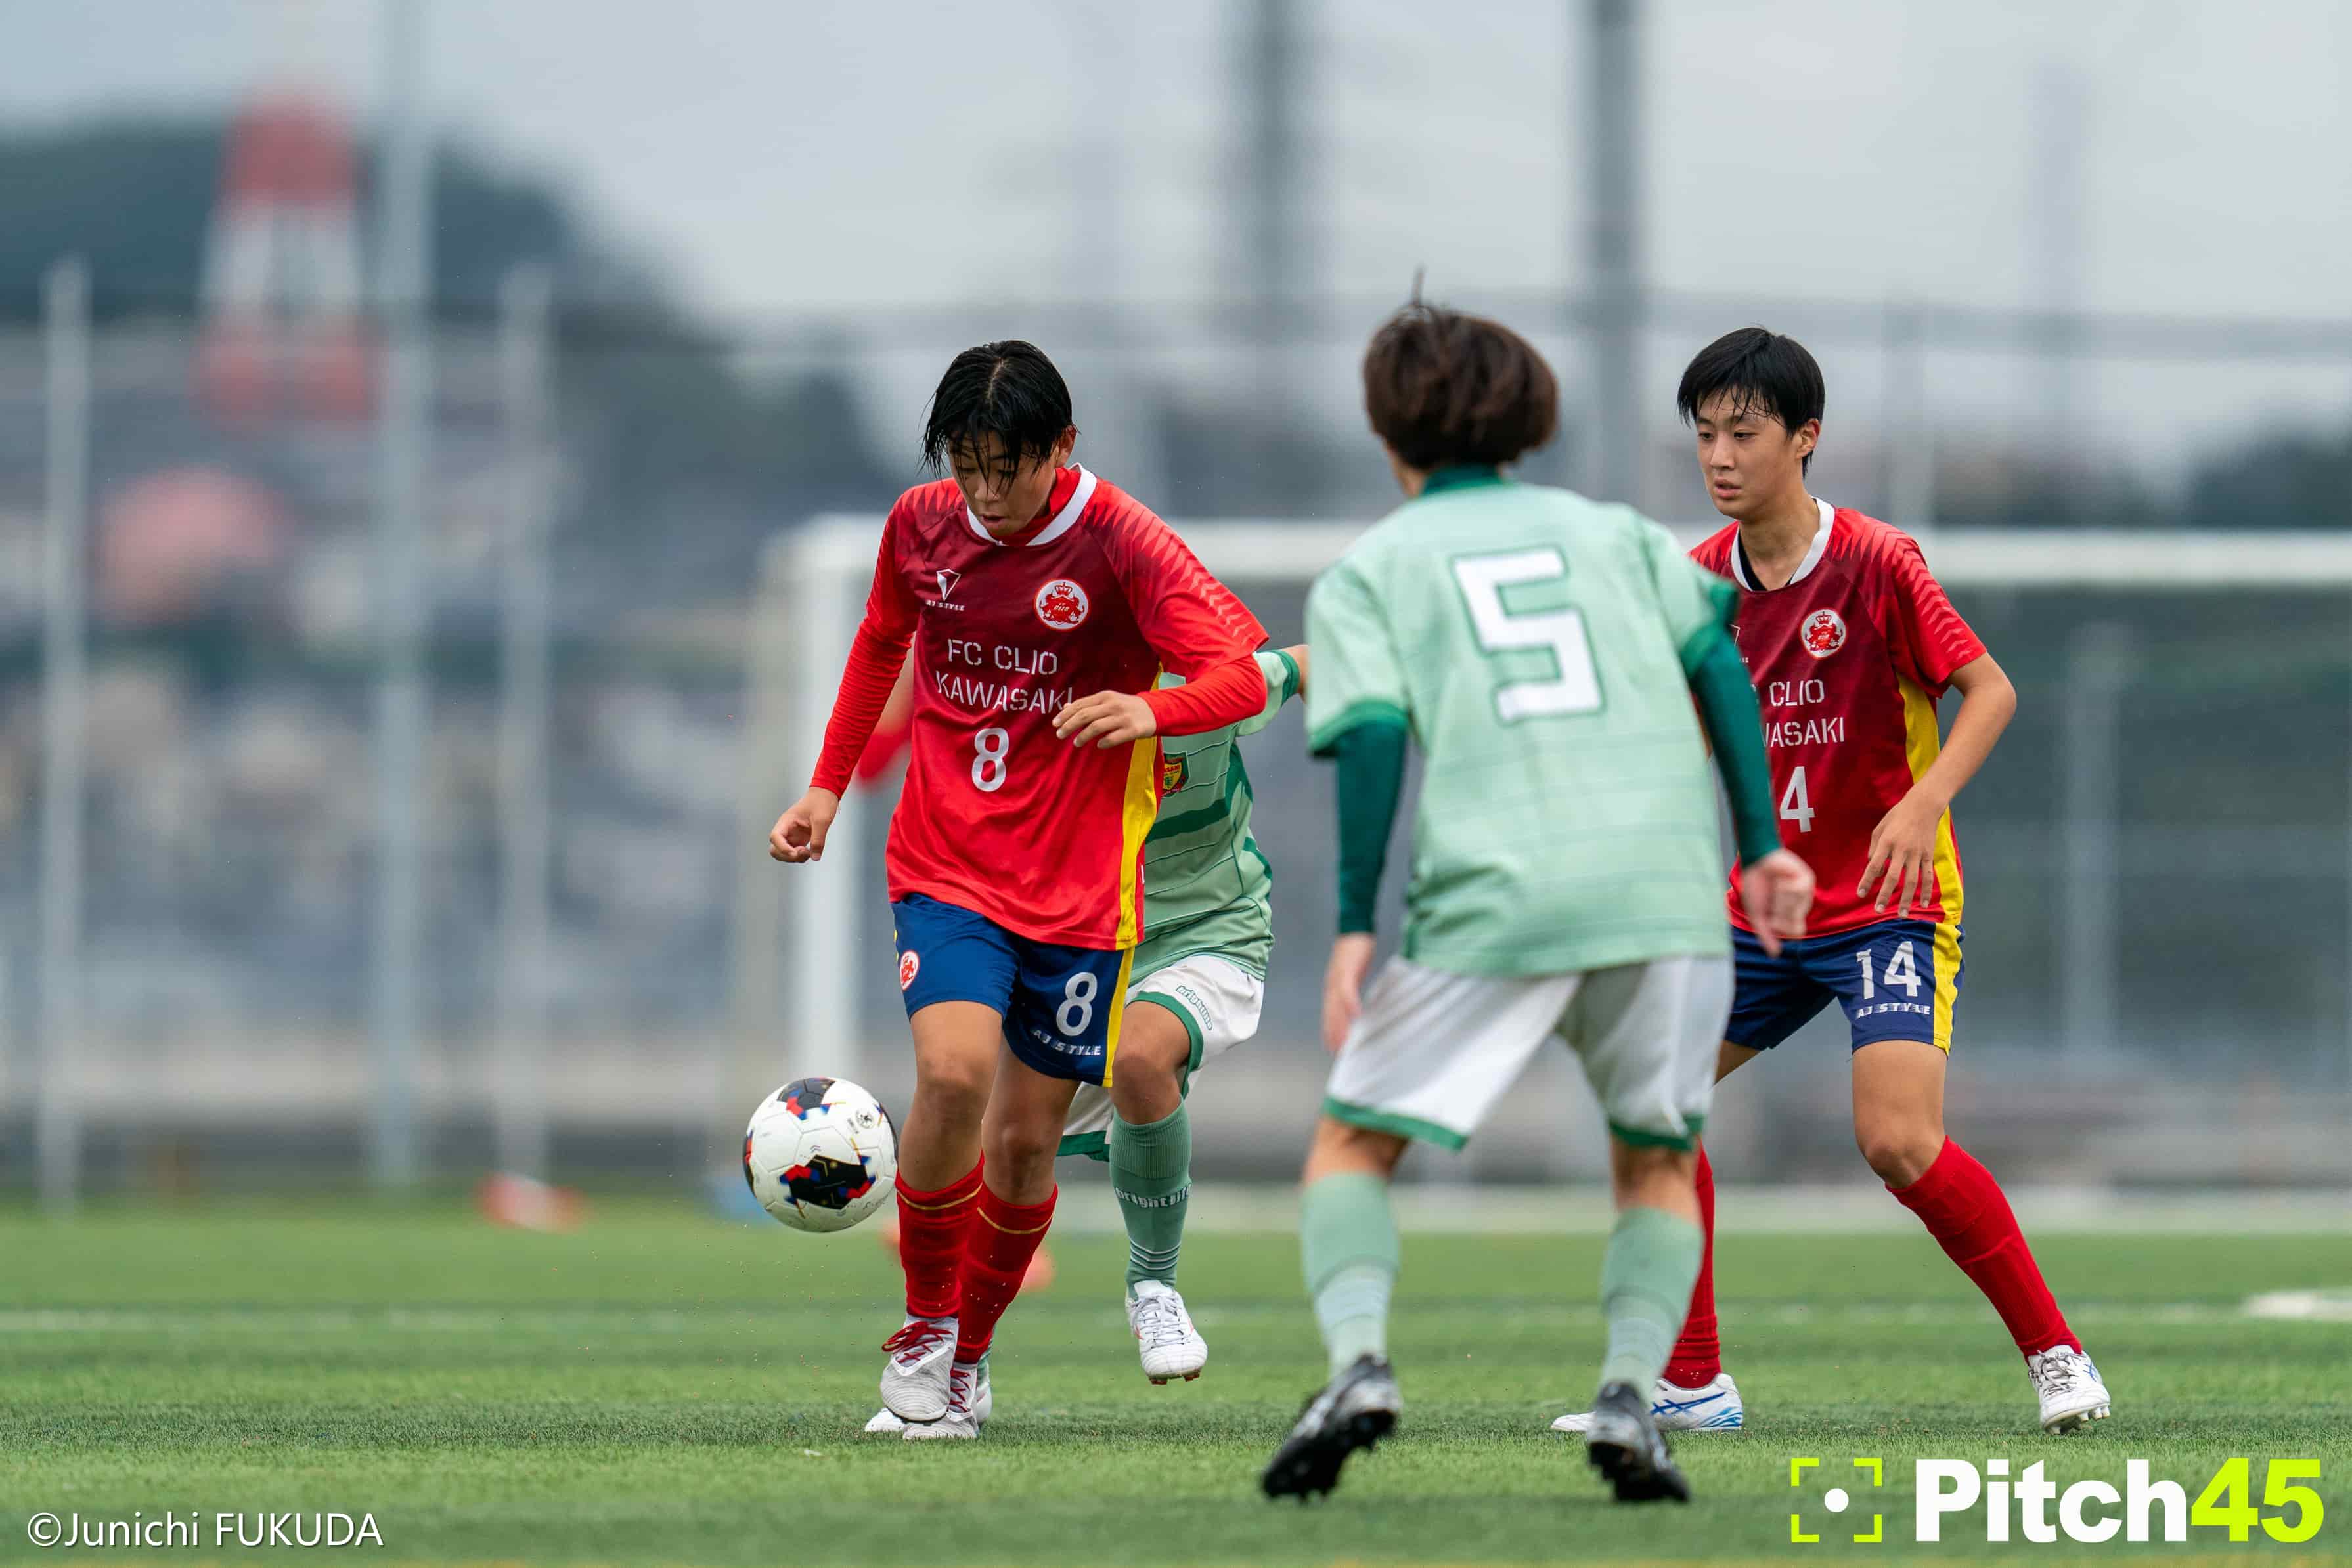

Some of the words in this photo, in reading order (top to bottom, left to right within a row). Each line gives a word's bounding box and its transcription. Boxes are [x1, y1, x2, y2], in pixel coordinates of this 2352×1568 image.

[947, 638, 982, 666] FC
[994, 645, 1058, 676] CLIO
[1449, 546, 1605, 725] 5
[936, 670, 1073, 714] KAWASAKI
[1769, 678, 1825, 707] CLIO
[971, 728, 1009, 792] 8
[1855, 940, 1922, 999] 14
[1055, 971, 1098, 1037] 8
[1878, 1002, 1930, 1014] STYLE
[1054, 1041, 1101, 1055] STYLE
